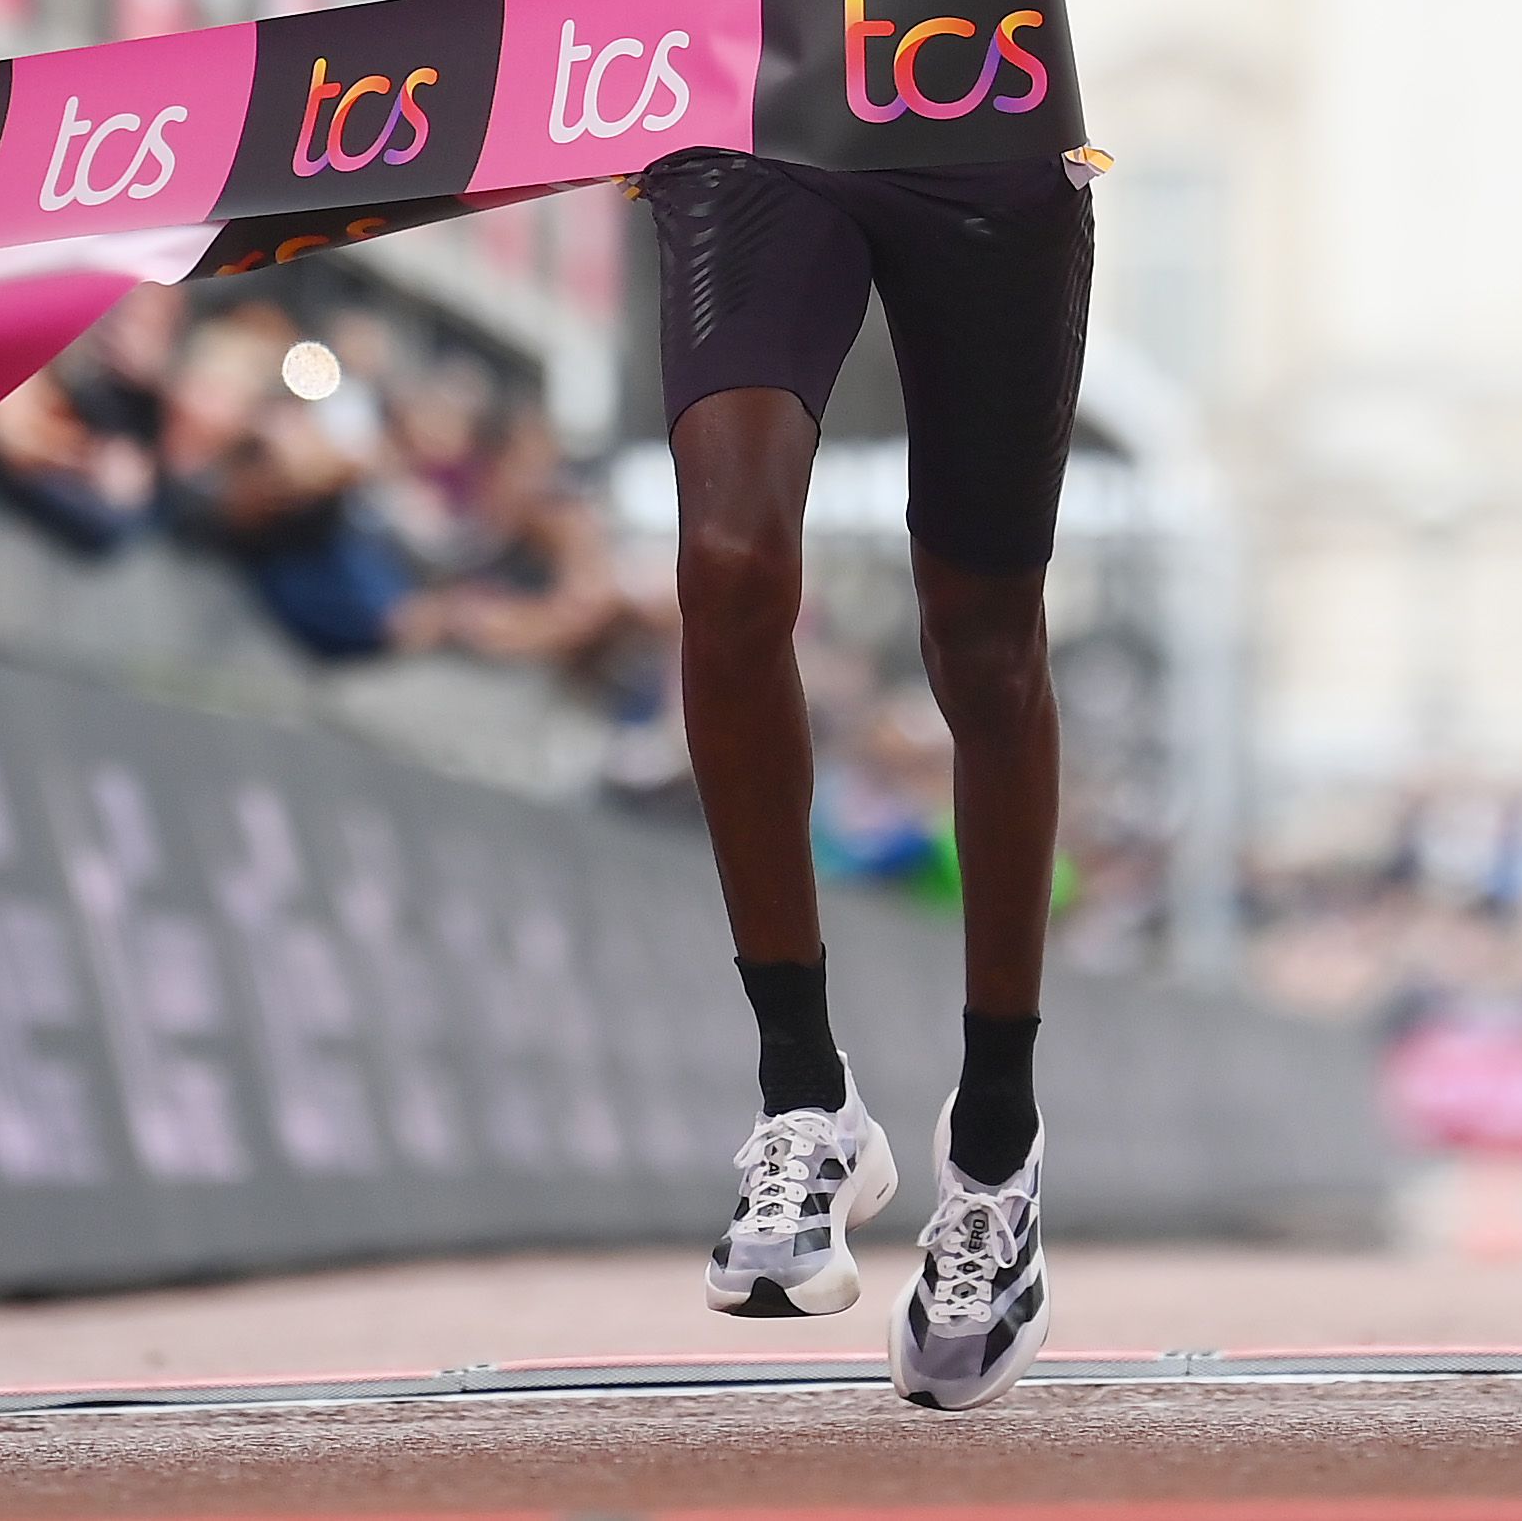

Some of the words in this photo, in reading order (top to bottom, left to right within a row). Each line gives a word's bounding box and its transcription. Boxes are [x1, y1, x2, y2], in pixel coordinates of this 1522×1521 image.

[291, 58, 438, 178] tcs
[548, 19, 690, 144] tcs
[38, 95, 188, 212] tcs
